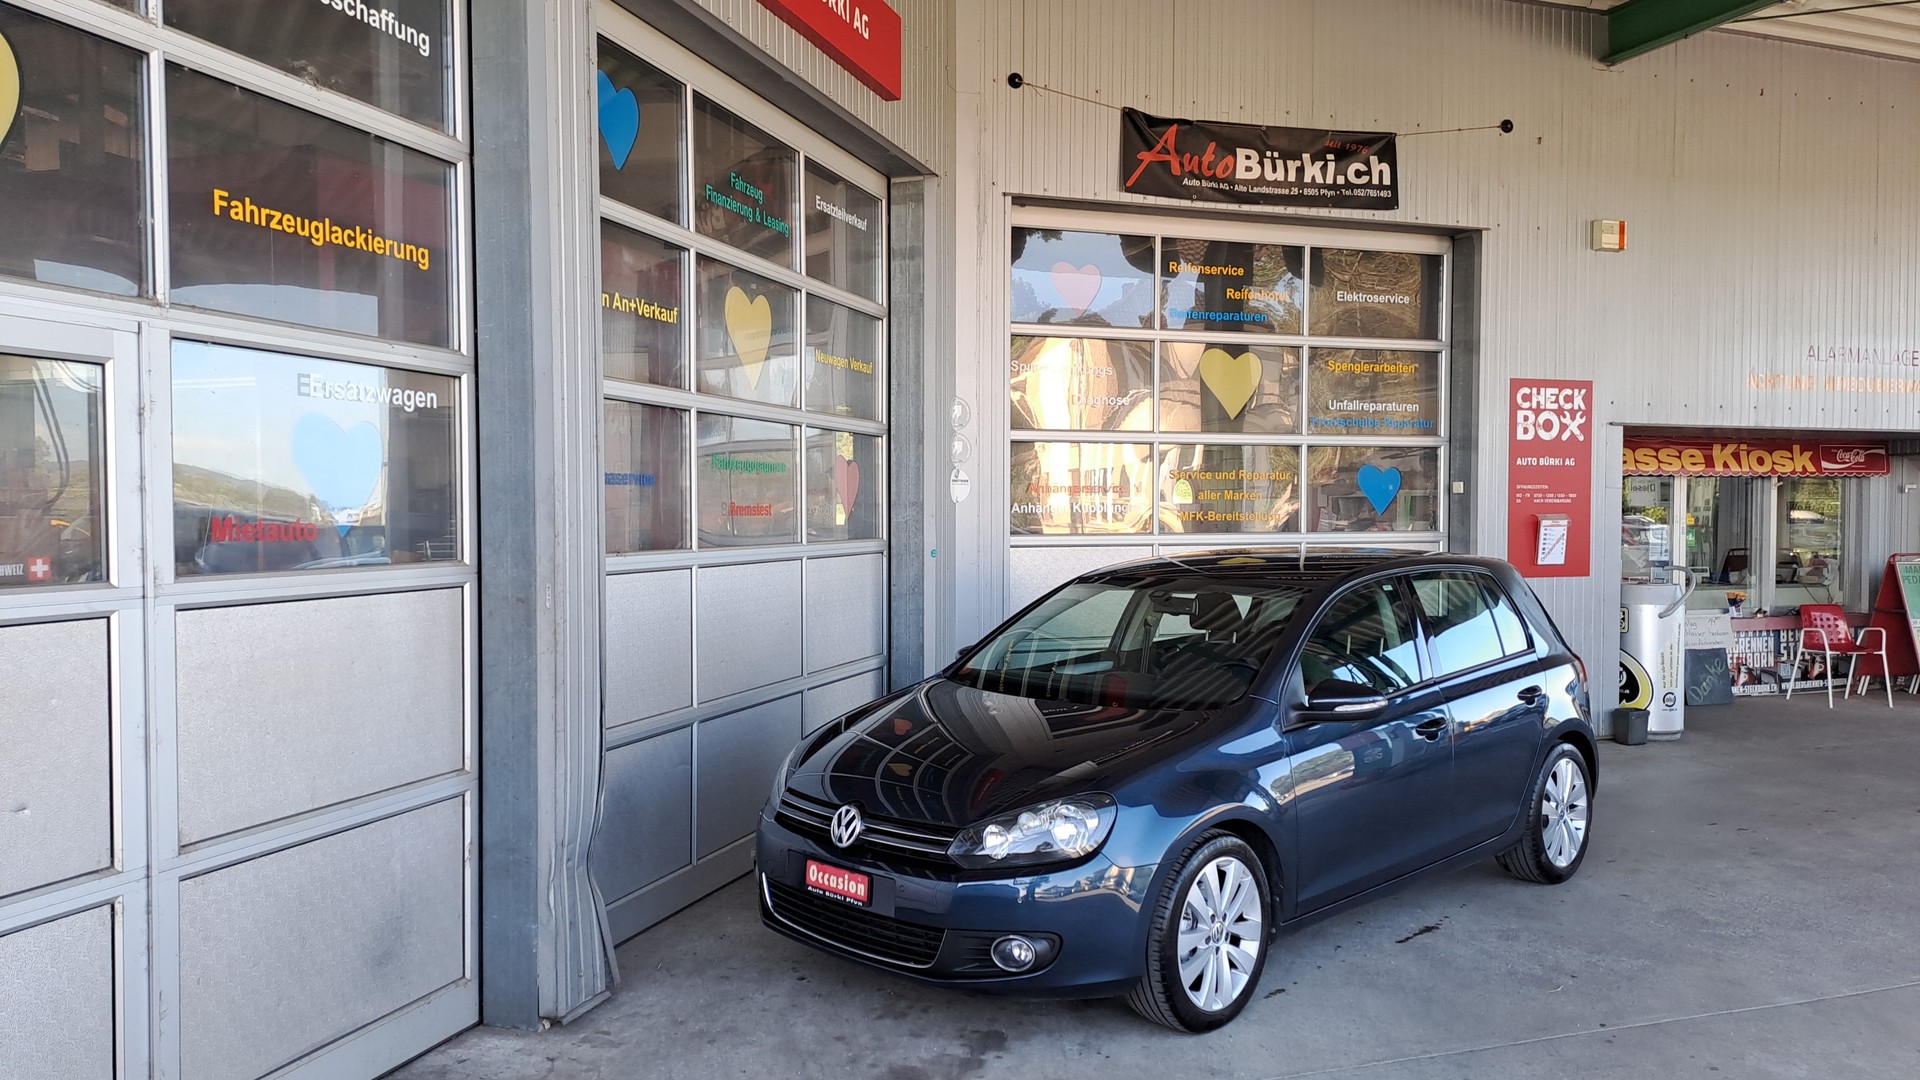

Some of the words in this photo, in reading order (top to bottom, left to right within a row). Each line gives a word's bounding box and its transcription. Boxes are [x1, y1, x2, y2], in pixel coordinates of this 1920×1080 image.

[321, 0, 430, 57] schaffung
[853, 6, 870, 40] AG
[730, 171, 764, 205] Fahrzeug
[1182, 178, 1200, 187] Auto
[1201, 180, 1219, 189] Bürki
[1234, 184, 1248, 193] Alte
[1248, 185, 1290, 195] Landstrasse
[1303, 188, 1319, 196] 8505
[1320, 189, 1336, 197] Pfyn
[705, 183, 753, 222] Finanzierung
[755, 207, 761, 222] &
[763, 211, 790, 238] Leasing
[815, 194, 868, 232] Ersatzteilverkauf
[213, 188, 430, 271] Fahrzeuglackierung
[1168, 261, 1245, 276] Reifenservice
[612, 291, 678, 324] An+Verkauf
[1226, 288, 1290, 303] Reifenhotel
[1336, 290, 1410, 304] Elektroservice
[1169, 307, 1268, 323] Reifenreparaturen
[815, 348, 849, 370] Neuwagen
[849, 356, 873, 375] Verkauf
[1327, 360, 1416, 374] Spenglerarbeiten
[309, 373, 438, 413] Ersatzwagen
[1073, 394, 1130, 409] Diagnose
[1516, 387, 1587, 411] CHECK
[1328, 400, 1420, 414] Unfallreparaturen
[1516, 410, 1587, 441] BOX
[1516, 457, 1538, 466] AUTO
[1539, 456, 1563, 466] BÜRKI
[1564, 458, 1576, 467] AG
[1713, 443, 1813, 474] Kiosk
[1172, 470, 1212, 481] Service
[1215, 470, 1236, 481] und
[1238, 470, 1290, 484] Reparatur
[1198, 490, 1221, 501] aller
[1224, 490, 1262, 501] Marken
[729, 501, 772, 517] Bremstest
[211, 516, 318, 543] Mietauto
[1689, 658, 1727, 703] Danke
[807, 885, 824, 895] Auto
[825, 891, 844, 901] Bürki
[809, 864, 865, 897] Occasion
